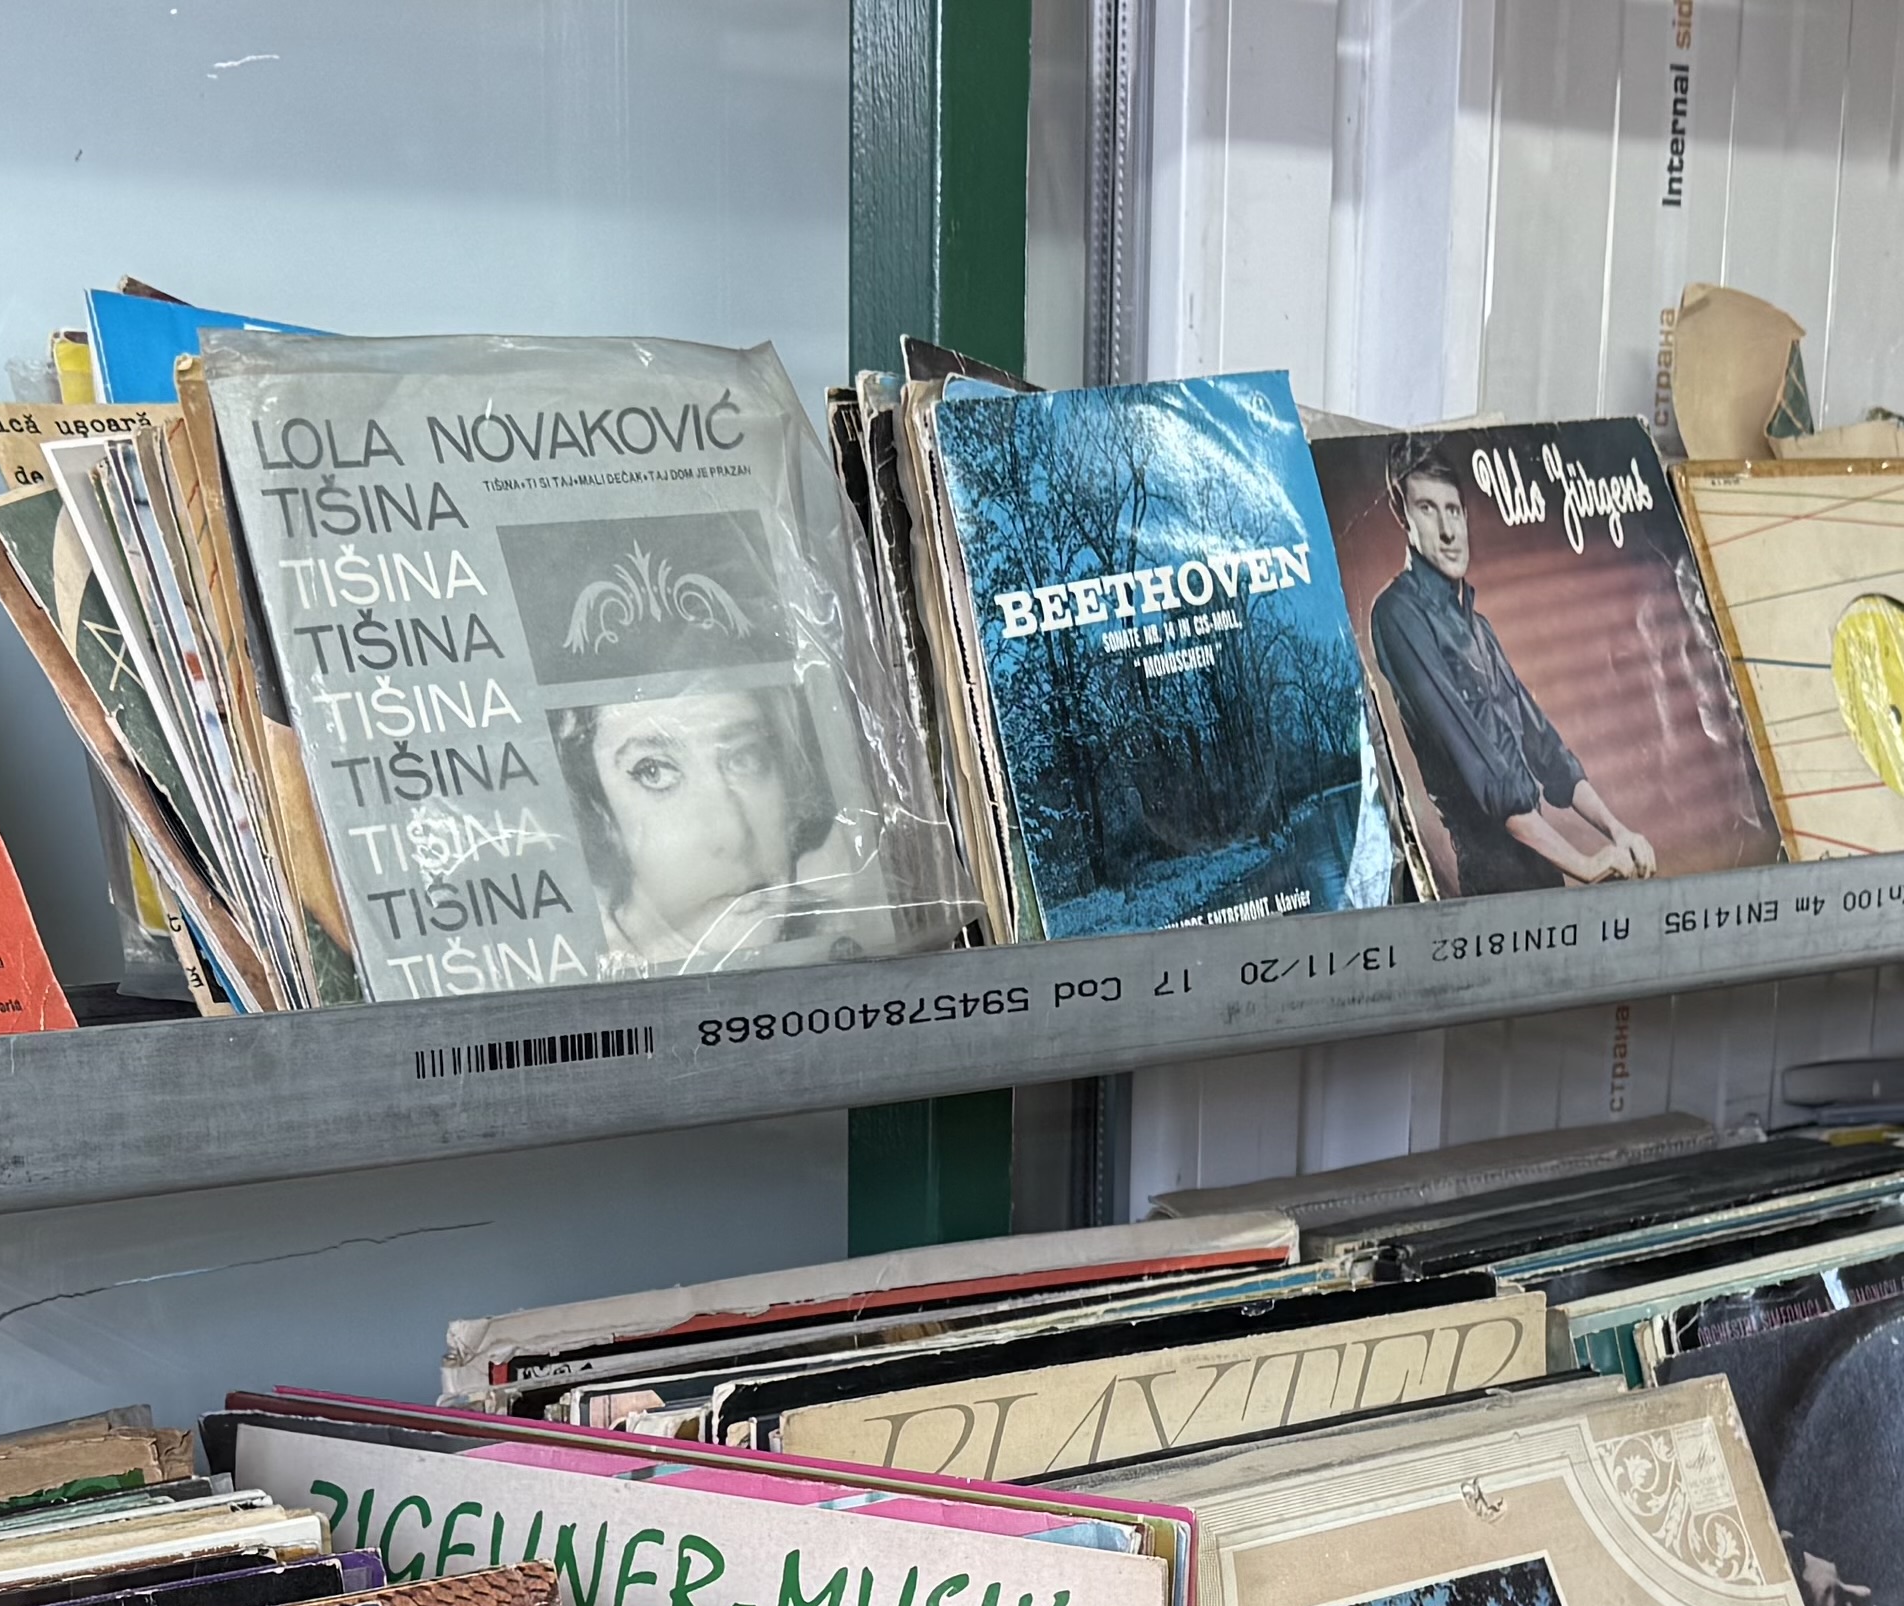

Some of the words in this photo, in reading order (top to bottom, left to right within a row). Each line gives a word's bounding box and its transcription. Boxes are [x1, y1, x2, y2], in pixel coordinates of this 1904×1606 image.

[1673, 0, 1693, 50] sid
[1662, 62, 1691, 208] Internal
[252, 416, 404, 470] LOLA
[427, 389, 746, 463] NOVAKOVIĆ
[260, 473, 469, 539] TIŠINA
[1473, 447, 1546, 527] Udo
[278, 544, 488, 609] TIŠINA
[995, 543, 1312, 639] BEETHOVEN
[295, 609, 505, 675] TIŠINA
[1102, 627, 1141, 653] SONATE
[1164, 622, 1176, 641] 14
[313, 676, 523, 742] TIŠINA
[331, 740, 540, 807] TIŠINA
[349, 806, 558, 875] TIŠINA
[367, 869, 575, 941] TIŠINA
[1600, 917, 1631, 942] A1
[1664, 899, 1780, 934] EN14195
[1796, 894, 1826, 914] 4m
[387, 932, 588, 1000] TIŠINA
[1241, 947, 1398, 986] 13/11/20
[1432, 923, 1579, 962] DIN18182
[1053, 976, 1123, 1009] Cod
[1154, 969, 1192, 996] 17
[698, 987, 1030, 1048] 5945784000868
[1609, 1005, 1630, 1113] страна
